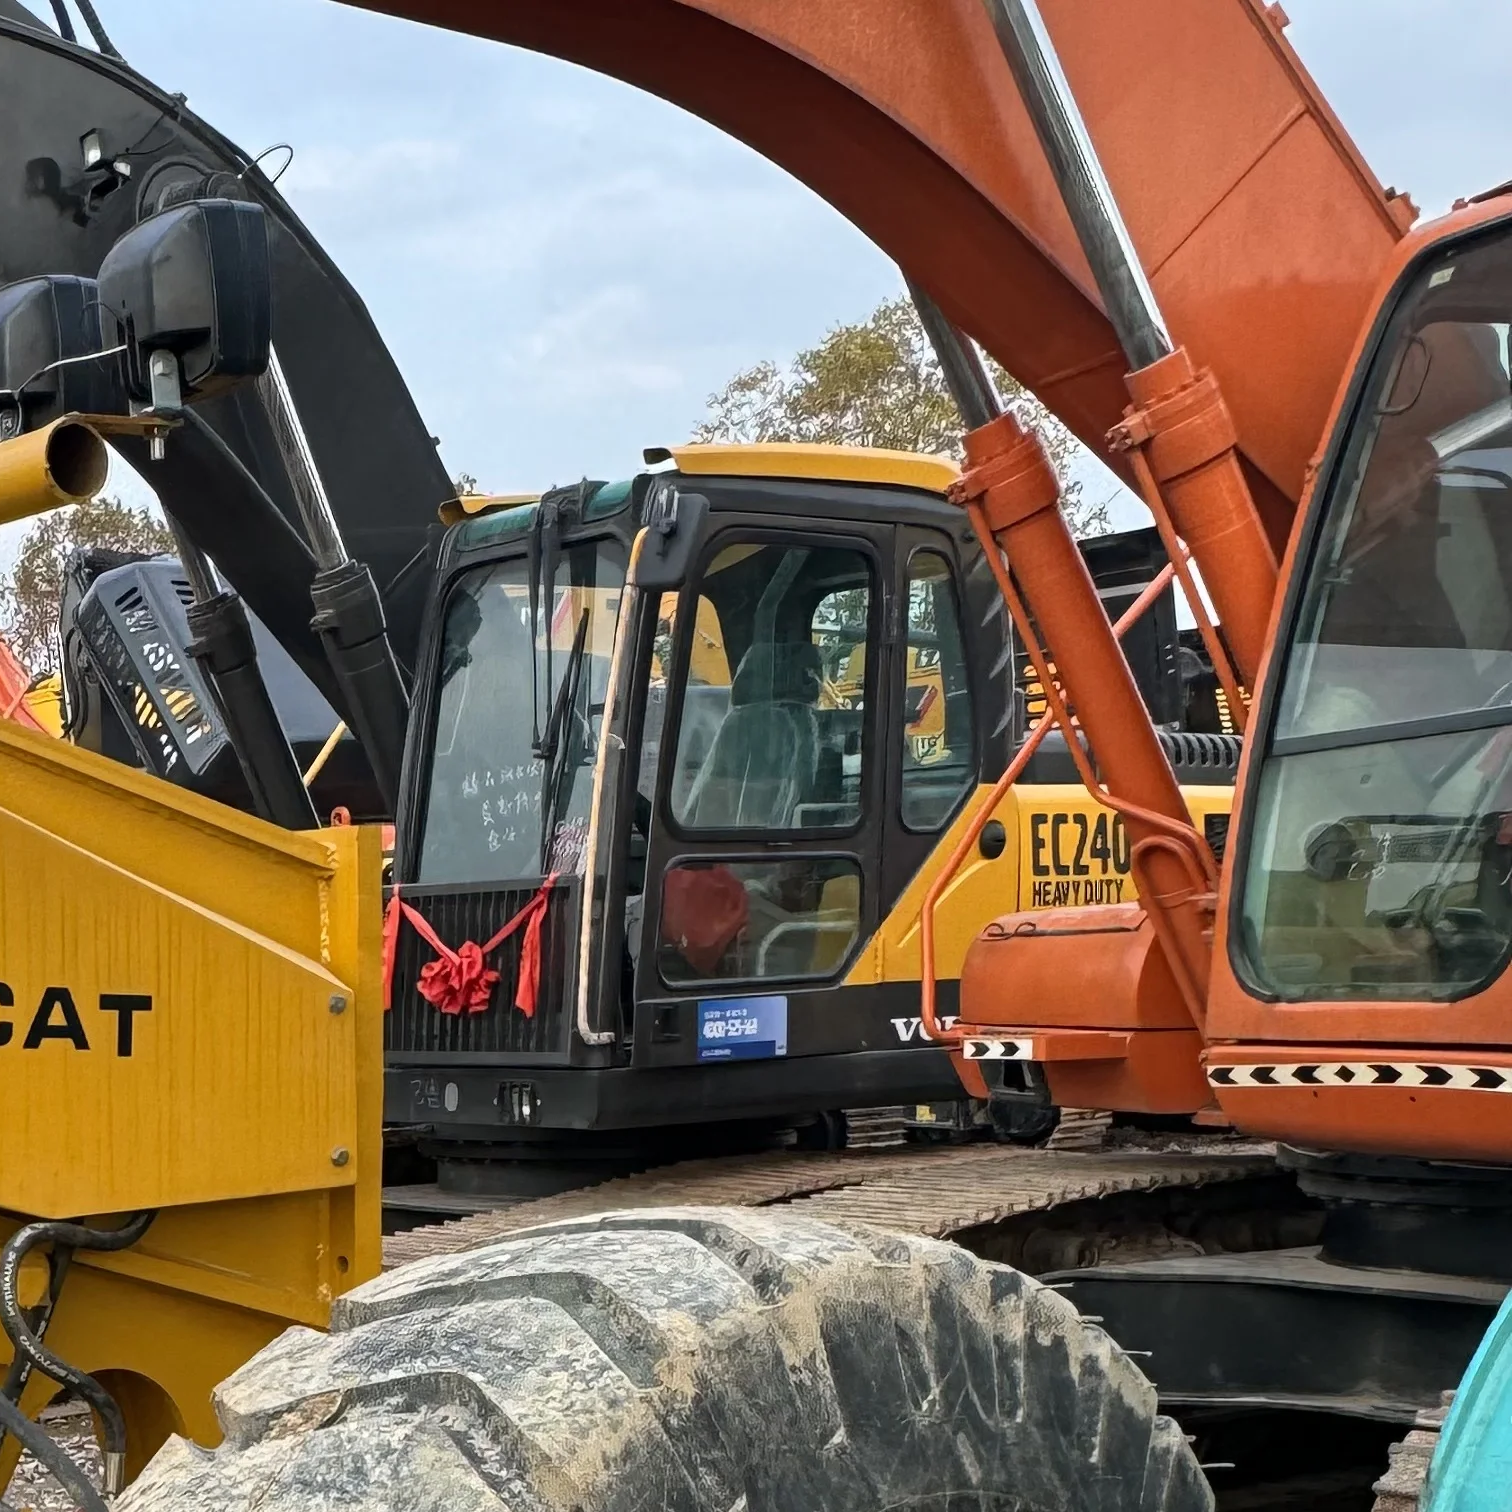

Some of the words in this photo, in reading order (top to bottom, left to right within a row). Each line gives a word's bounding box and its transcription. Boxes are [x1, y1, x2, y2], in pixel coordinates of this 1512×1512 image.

[1031, 813, 1131, 876] EC240
[1032, 880, 1080, 907] HEAVY
[1084, 878, 1124, 905] DUTY
